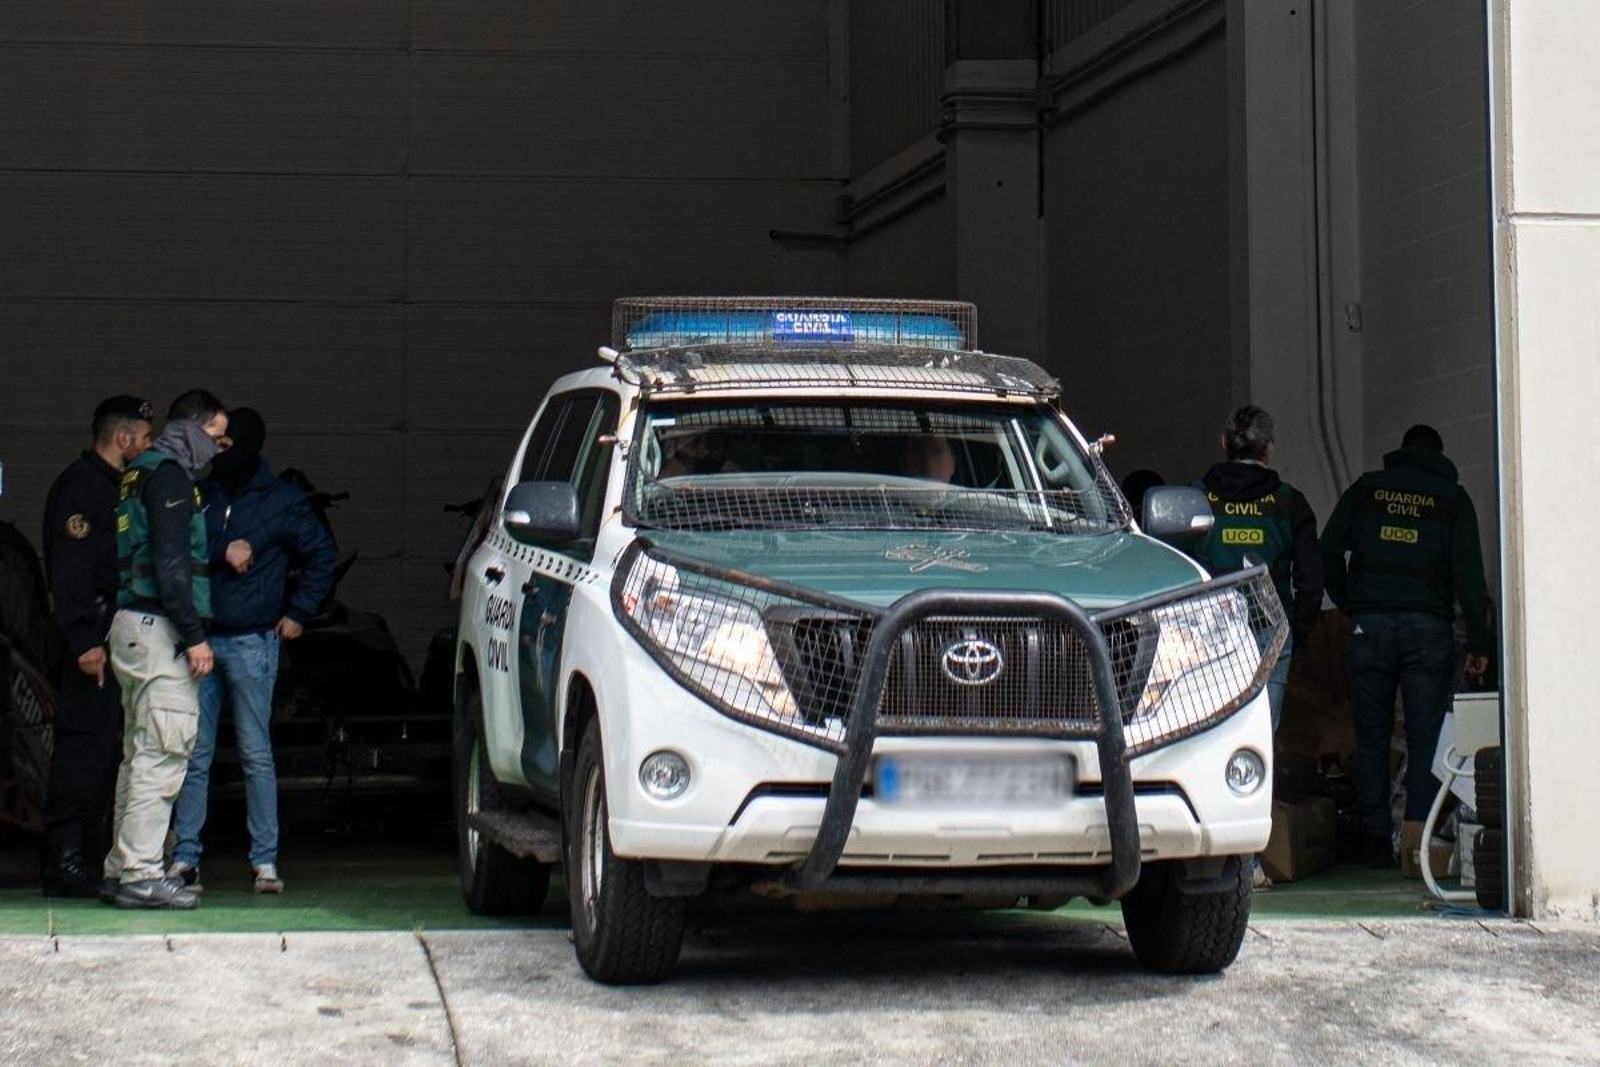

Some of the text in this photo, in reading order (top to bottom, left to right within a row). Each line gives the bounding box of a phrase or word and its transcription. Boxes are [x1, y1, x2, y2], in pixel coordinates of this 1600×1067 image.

[776, 312, 847, 323] GUARDIA
[793, 322, 832, 333] CIVIL
[1373, 488, 1435, 508] GUARDIA
[1224, 502, 1263, 516] CIVIL
[1386, 502, 1421, 518] CIVIL
[1225, 530, 1261, 542] UCO
[1383, 527, 1415, 542] UCO
[487, 636, 509, 672] CIVIL
